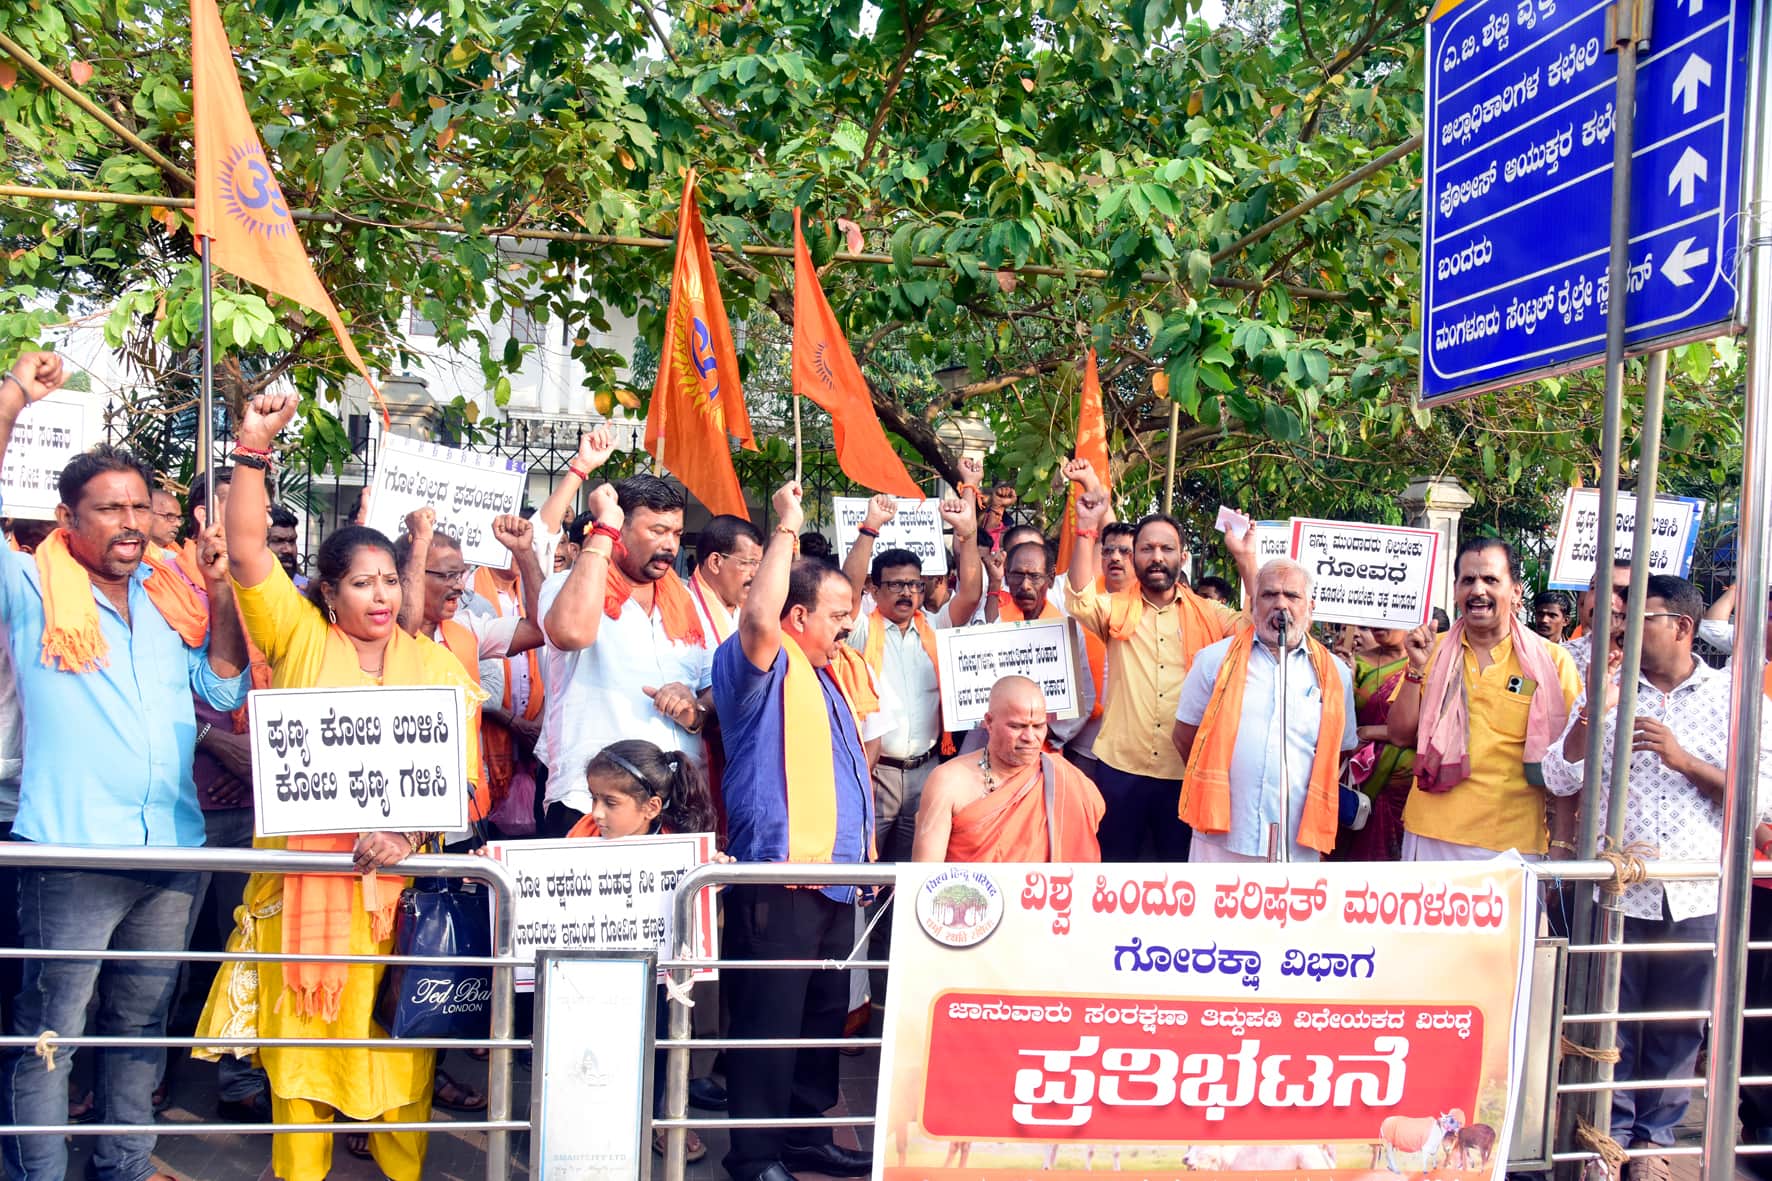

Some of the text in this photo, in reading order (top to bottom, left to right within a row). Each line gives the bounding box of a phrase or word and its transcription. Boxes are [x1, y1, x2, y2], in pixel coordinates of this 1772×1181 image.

[1441, 37, 1600, 146] ಜಿಲ್ಲಾಧಿಕಾರಿಗಳ ಕಛೇರಿ
[1503, 122, 1573, 183] ಆಯುಕ್ತರ
[1437, 233, 1493, 281] ಬಂದರು
[1435, 304, 1500, 352] ಮಂಗಳೂರು
[1505, 284, 1555, 335] ಸೆಂಟ್ರಲ್
[1316, 556, 1408, 586] ಗೋವಧೆ
[267, 707, 449, 767] ಪುಣ್ಯ ಕೋಟಿ ಉಳಿಸಿ
[275, 760, 447, 817] ಕೋಟಿ ಪುಣ್ಯ ಗಳಿಸಿ
[546, 868, 593, 910] ರಕ್ಷಣೆಯ
[598, 867, 633, 908] ಮಹತ್ವ
[639, 870, 655, 894] ನೀ
[1020, 871, 1504, 936] ವಿಶ್ವ ಹಿಂದೂ ಪರಿಷತ್ ಮಂಗಳೂರು
[600, 914, 638, 944] ಗೋವಿನ
[1114, 937, 1375, 991] ಗೋರಕ್ಷಾ ವಿಭಾಗ
[411, 977, 492, 1011] Ted Ba
[442, 1003, 483, 1014] LONDON
[948, 1001, 1473, 1039] ಜಾನುವಾರು ಸಂರಕ್ಷಣಾ ತಿದ್ದುಪಡಿ ವಿಧೇಯಕದ ವಿರುದ್ಧ
[1011, 1035, 1410, 1127] ಪ್ರತಿಭಟನೆ
